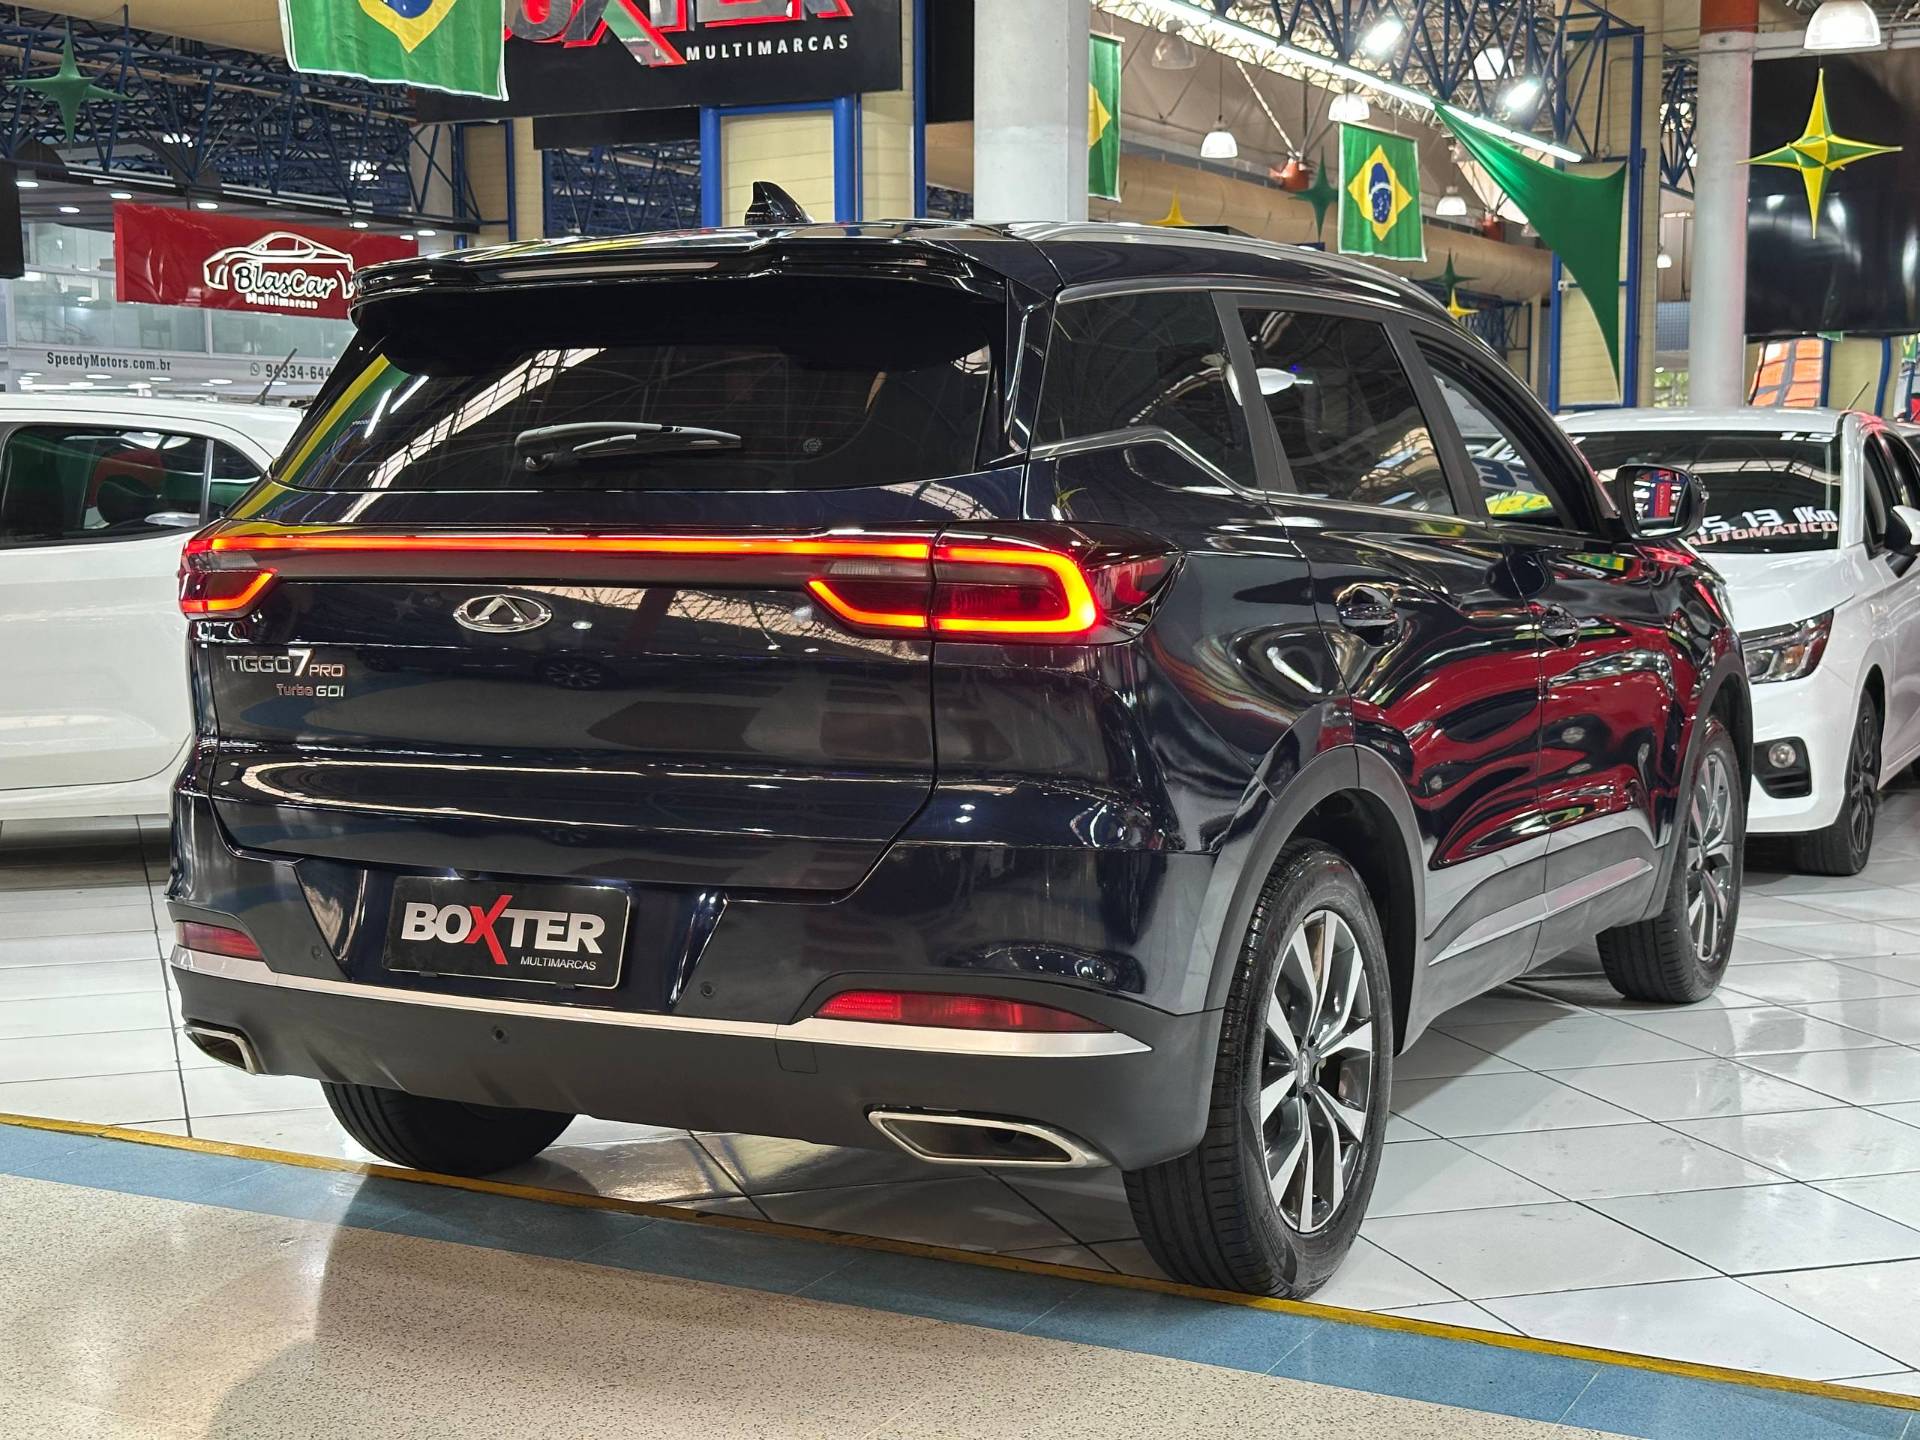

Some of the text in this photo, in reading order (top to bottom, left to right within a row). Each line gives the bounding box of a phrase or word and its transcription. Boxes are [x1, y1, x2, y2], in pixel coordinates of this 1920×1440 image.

[686, 34, 848, 61] MULTIMARCAS
[233, 262, 337, 298] BlasCar
[47, 351, 171, 371] SpeedyMotors.com.br
[276, 683, 314, 697] Turbo
[401, 894, 605, 966] BOXTER
[520, 956, 597, 971] MULTIMARCAS
